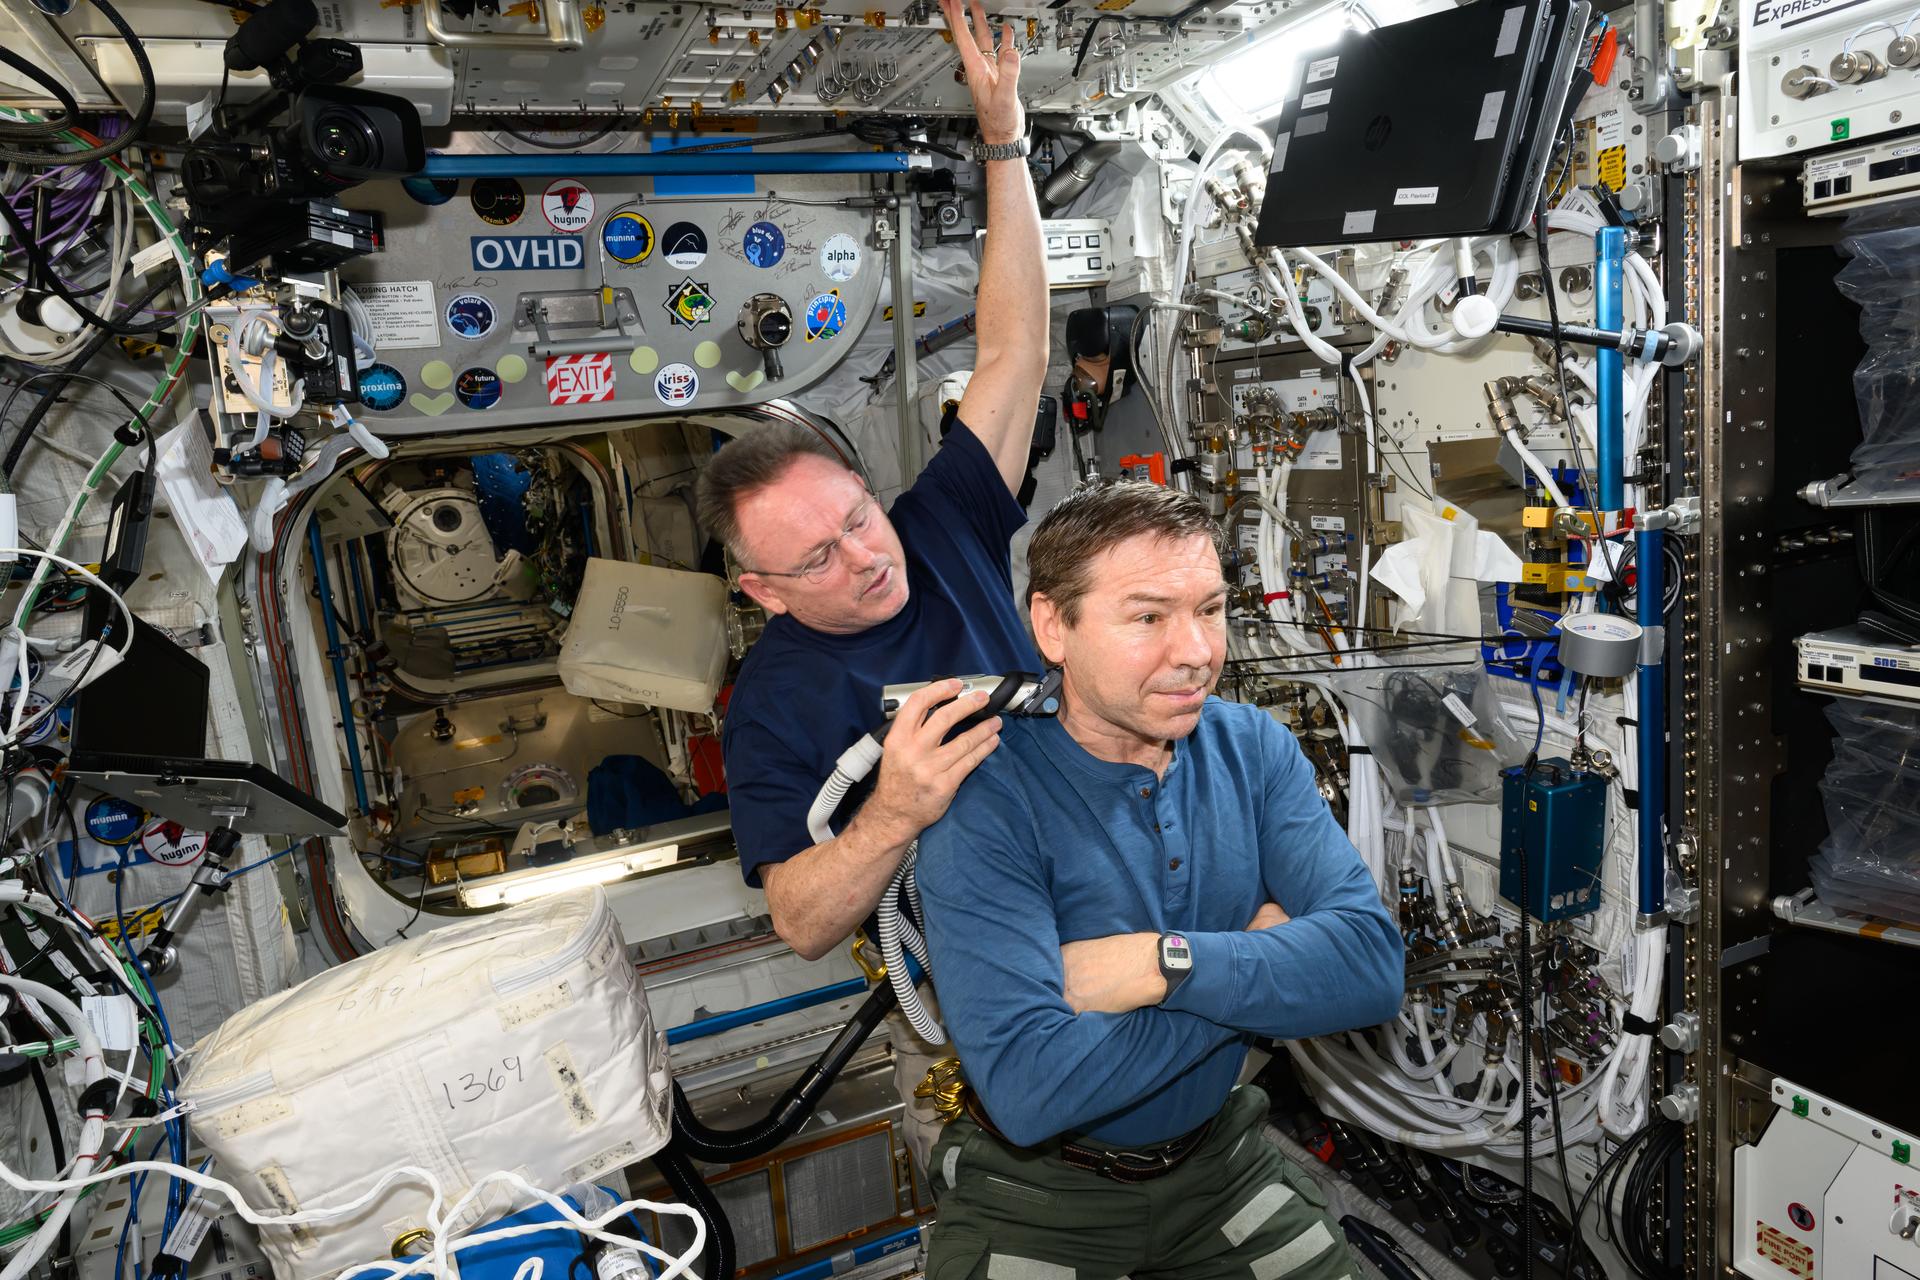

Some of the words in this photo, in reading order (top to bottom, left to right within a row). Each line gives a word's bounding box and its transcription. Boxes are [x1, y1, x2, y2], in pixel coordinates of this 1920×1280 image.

[1602, 109, 1618, 118] RPDA
[554, 215, 586, 226] huginn
[752, 227, 765, 235] blue
[765, 231, 774, 242] dot
[476, 239, 582, 268] OVHD
[827, 250, 855, 263] alpha
[808, 295, 836, 316] principia
[557, 366, 602, 392] EXIT
[664, 372, 689, 384] iriss
[360, 382, 402, 394] proxima
[608, 586, 630, 631] 10-5550
[90, 813, 128, 826] muninn
[160, 843, 200, 861] huginn
[1764, 1238, 1781, 1252] FIRE
[1783, 1249, 1806, 1264] PORT
